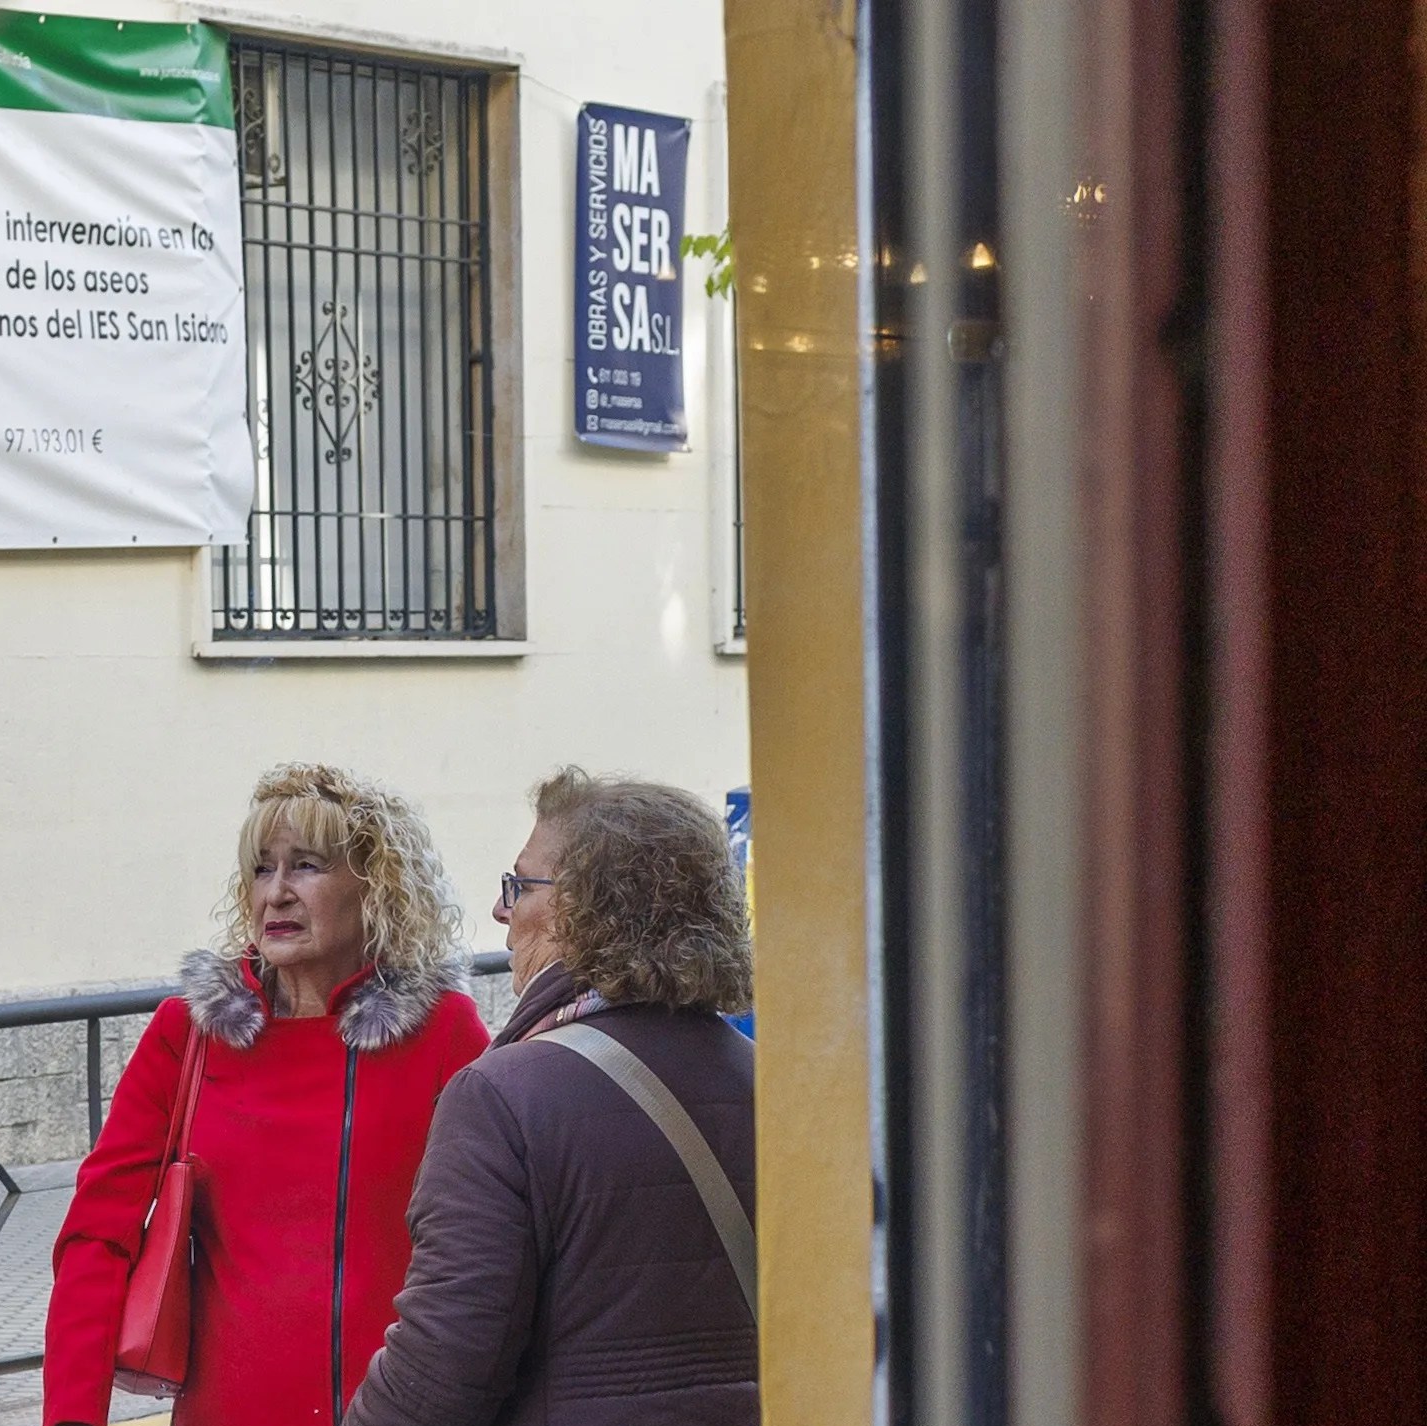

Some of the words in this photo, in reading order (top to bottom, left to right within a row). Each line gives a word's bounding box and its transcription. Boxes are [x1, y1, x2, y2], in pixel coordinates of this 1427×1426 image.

[588, 118, 608, 242] SERVICIOS
[612, 123, 661, 197] MA
[5, 210, 152, 248] intervención
[159, 227, 185, 250] en
[588, 245, 608, 263] Y
[612, 203, 673, 276] SER
[6, 259, 36, 290] de
[45, 260, 75, 291] los
[84, 269, 149, 294] aseos
[47, 308, 83, 339] del
[90, 310, 120, 340] IES
[127, 311, 168, 341] San
[587, 268, 608, 351] OBRAS
[612, 282, 651, 353] SA
[5, 428, 85, 454] 97.193,01
[92, 428, 103, 453] €
